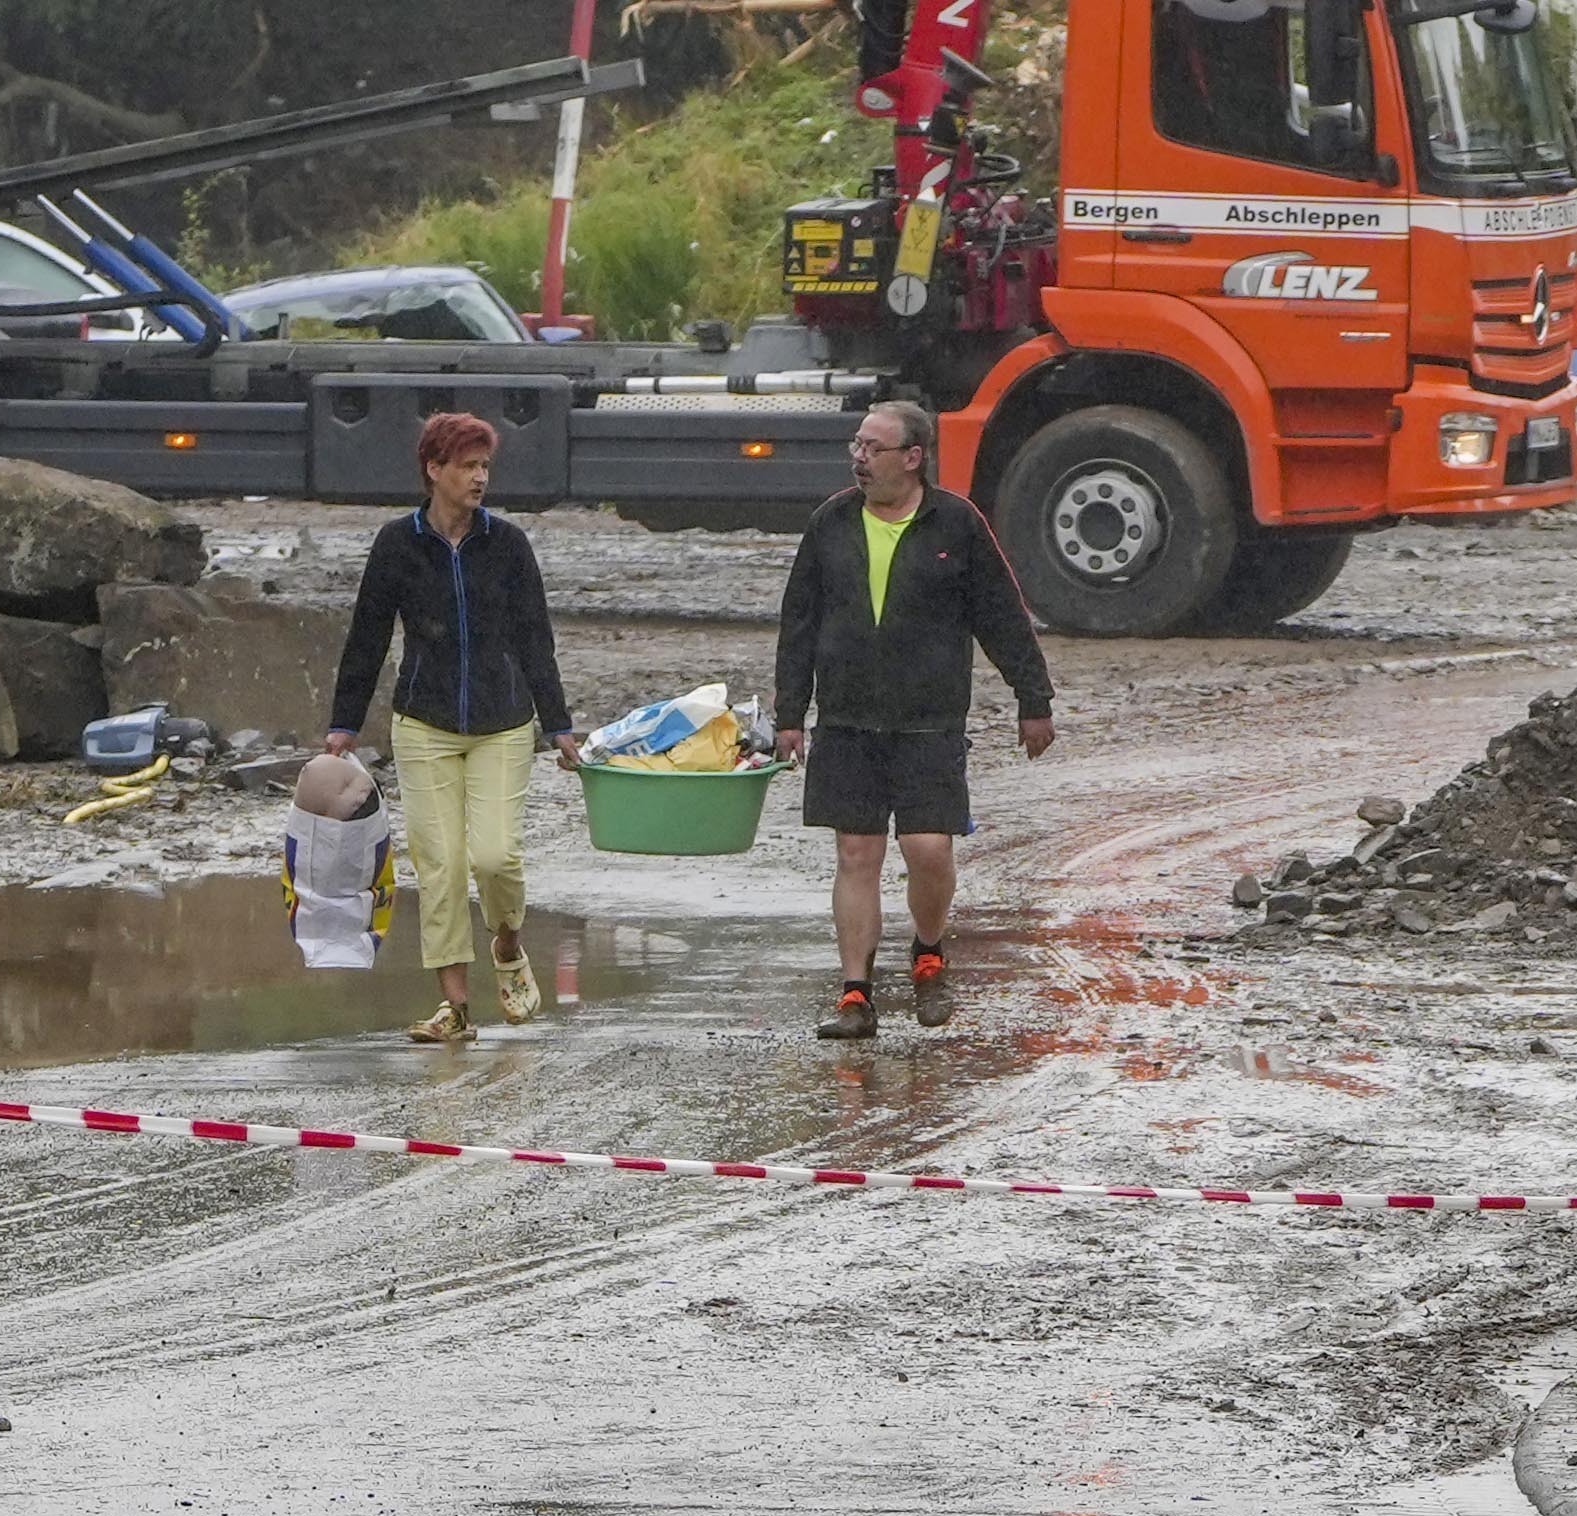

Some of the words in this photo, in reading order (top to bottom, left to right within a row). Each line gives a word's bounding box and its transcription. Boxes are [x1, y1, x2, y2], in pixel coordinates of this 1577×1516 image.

[1074, 201, 1159, 222] Bergen
[1225, 205, 1381, 229] Abschleppen
[1257, 266, 1378, 300] LENZ
